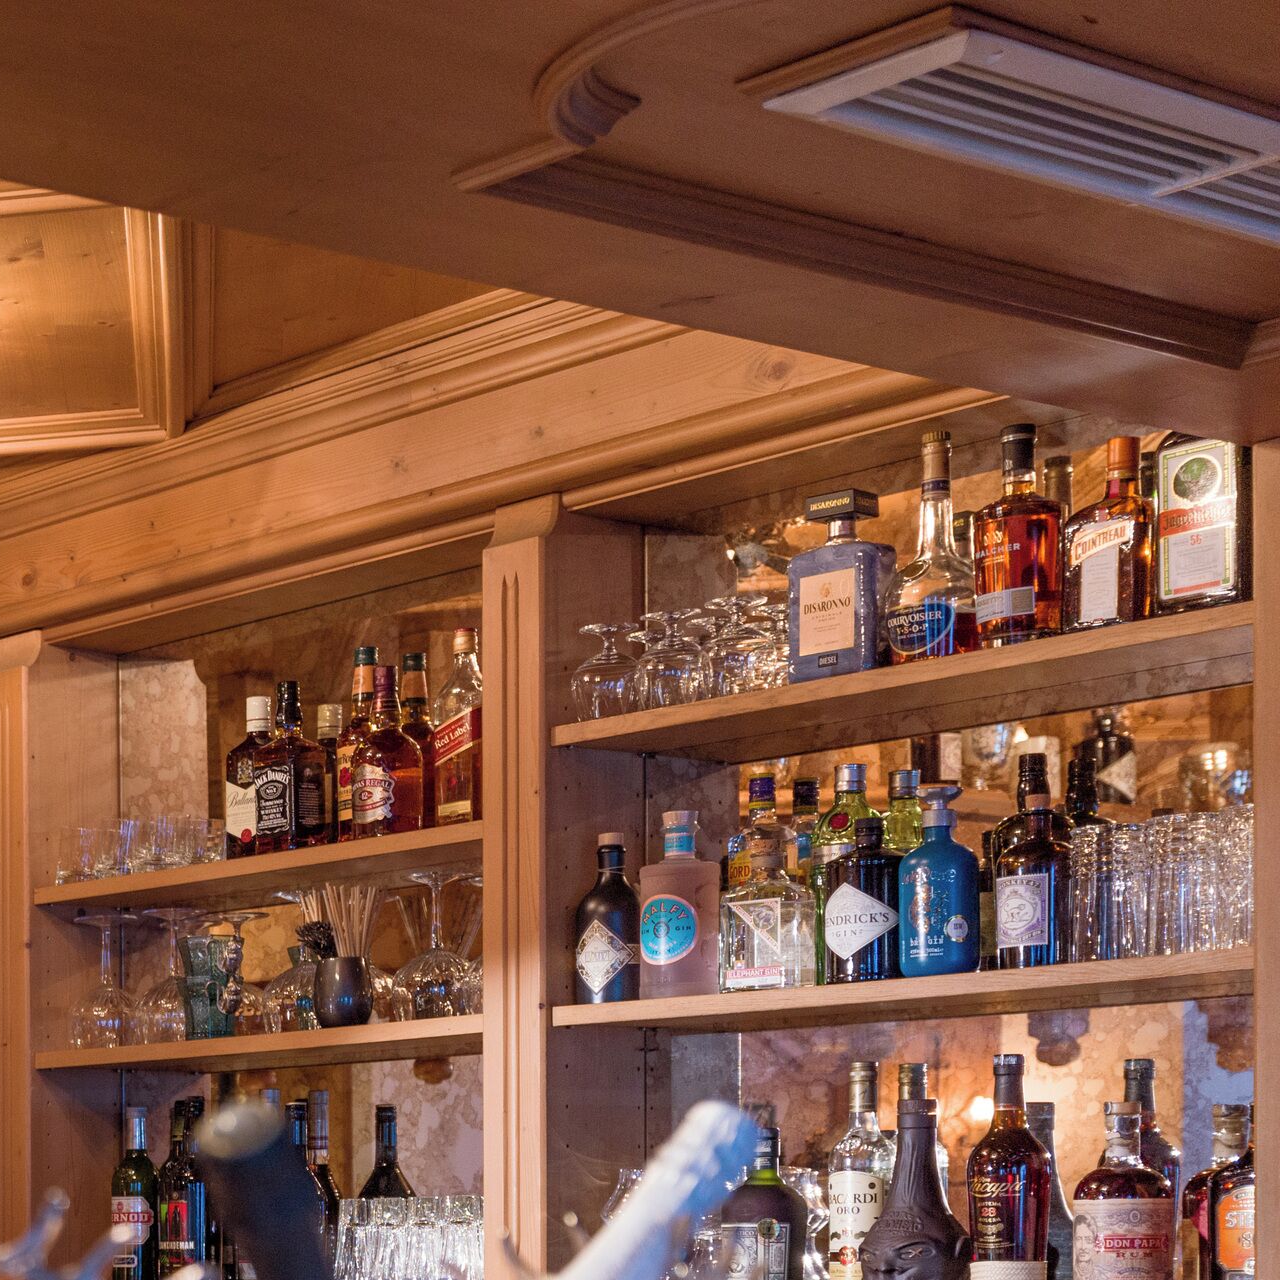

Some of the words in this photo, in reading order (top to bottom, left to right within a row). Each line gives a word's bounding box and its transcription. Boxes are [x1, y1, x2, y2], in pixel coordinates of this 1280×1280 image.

[1075, 526, 1126, 561] COINTREAU
[803, 596, 851, 615] DISARONNO
[818, 656, 837, 667] DIESEL
[434, 735, 450, 750] Red
[449, 722, 470, 740] Label
[644, 902, 689, 925] MALFY
[1104, 1239, 1130, 1248] DON
[1133, 1239, 1162, 1248] PAPA
